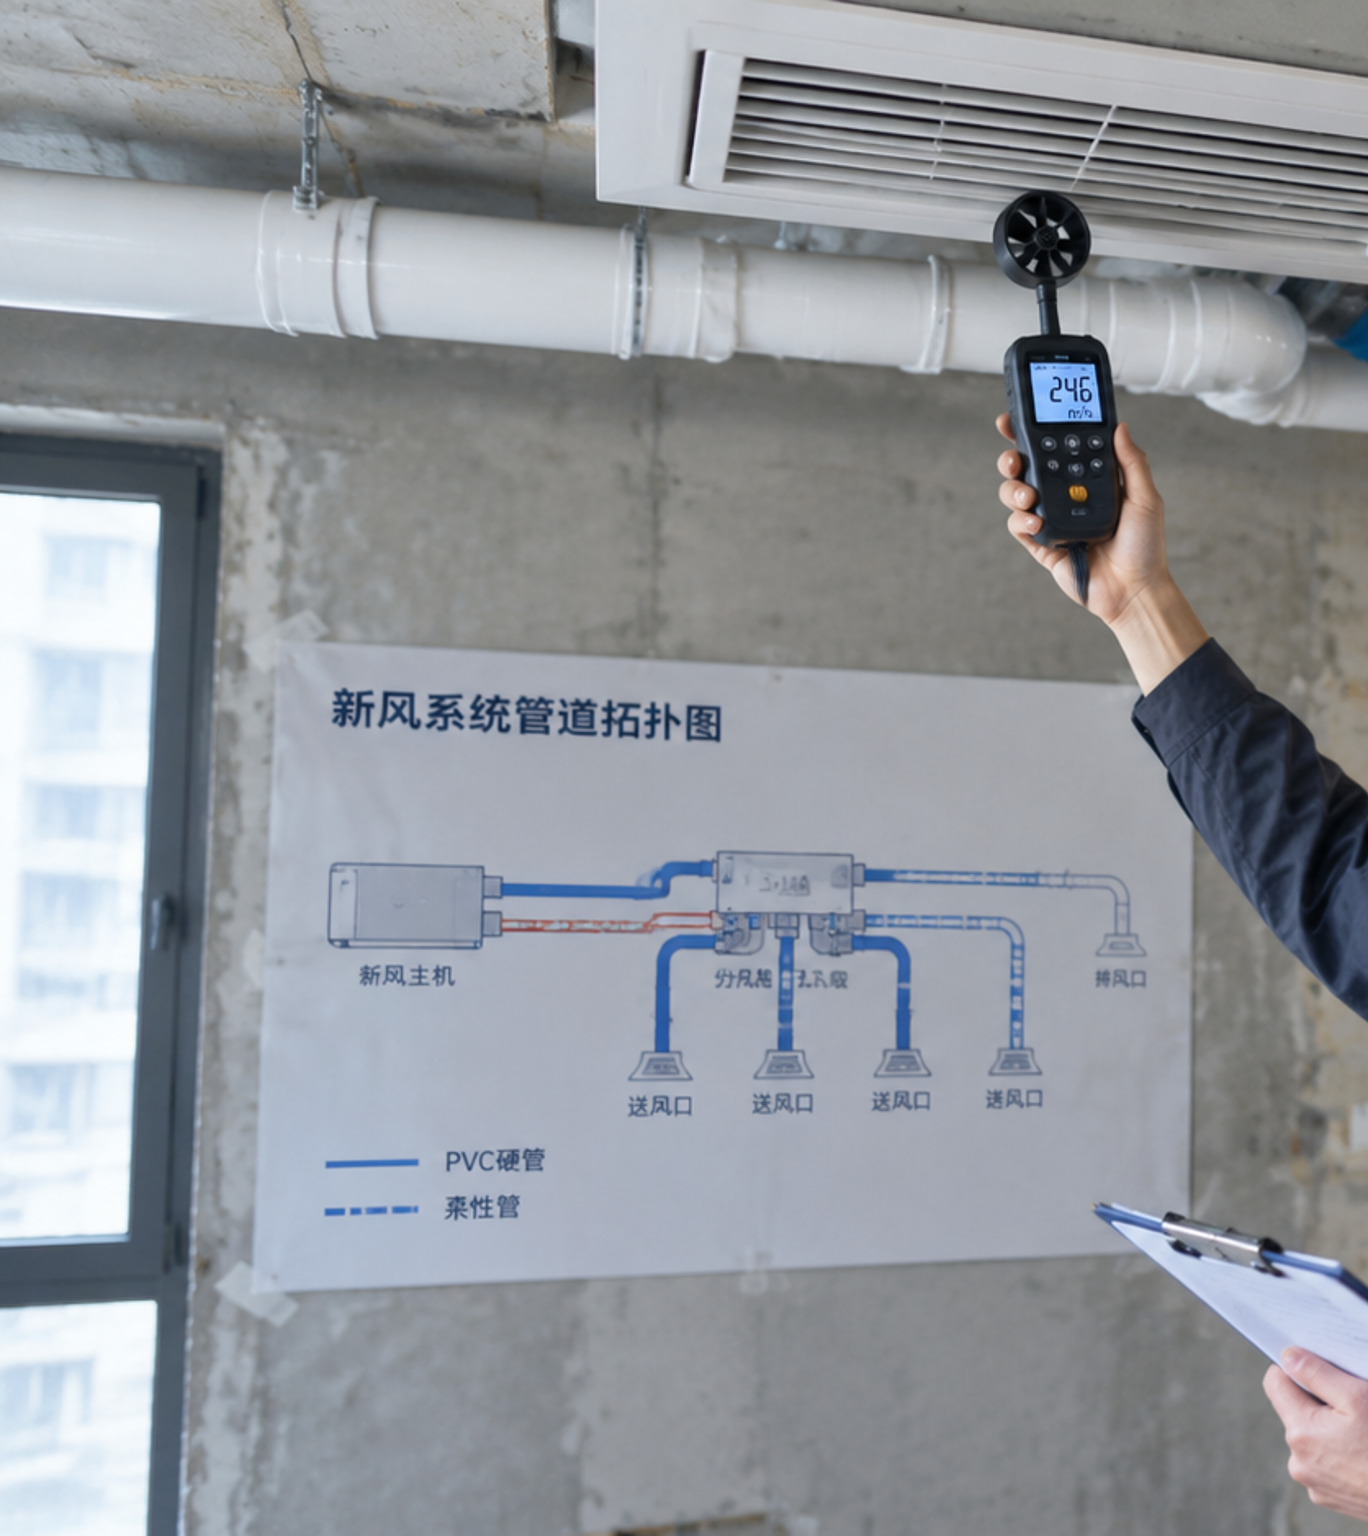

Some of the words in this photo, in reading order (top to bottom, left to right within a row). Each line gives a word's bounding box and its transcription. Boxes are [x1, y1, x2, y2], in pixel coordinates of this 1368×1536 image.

[331, 687, 722, 743] 新风系统管道拓扑图
[359, 964, 456, 987] 新风主机
[627, 1094, 693, 1118] 送风口
[752, 1092, 814, 1115] 送风口
[871, 1090, 931, 1112] 送风口
[986, 1088, 1043, 1110] 送风口
[445, 1147, 546, 1173] PVC硬管
